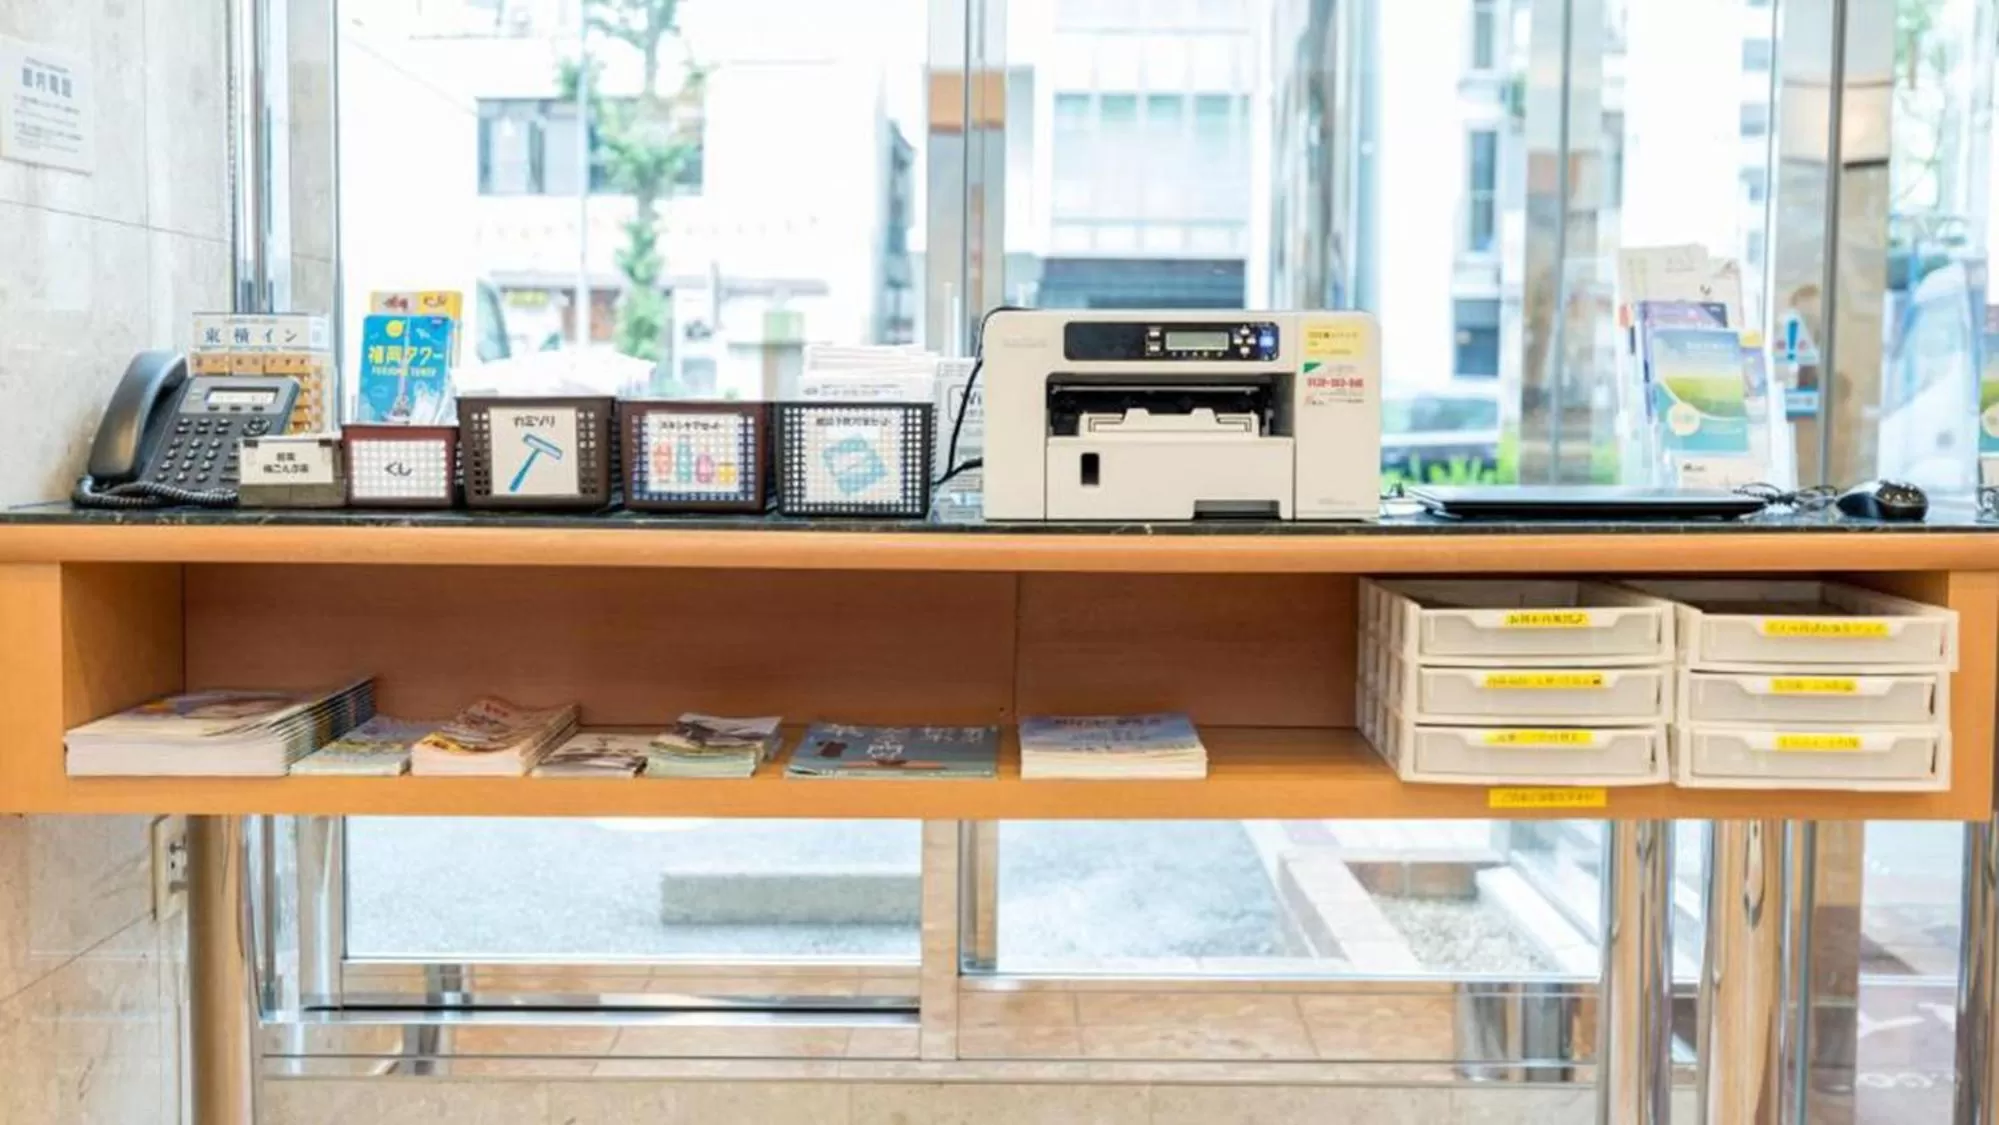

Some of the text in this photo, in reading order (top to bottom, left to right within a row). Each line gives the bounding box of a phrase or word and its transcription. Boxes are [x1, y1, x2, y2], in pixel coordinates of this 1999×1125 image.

[204, 327, 298, 344] 東横イン
[367, 345, 445, 366] 福岡タワー
[513, 415, 556, 428] カミソリ
[385, 461, 412, 477] くし
